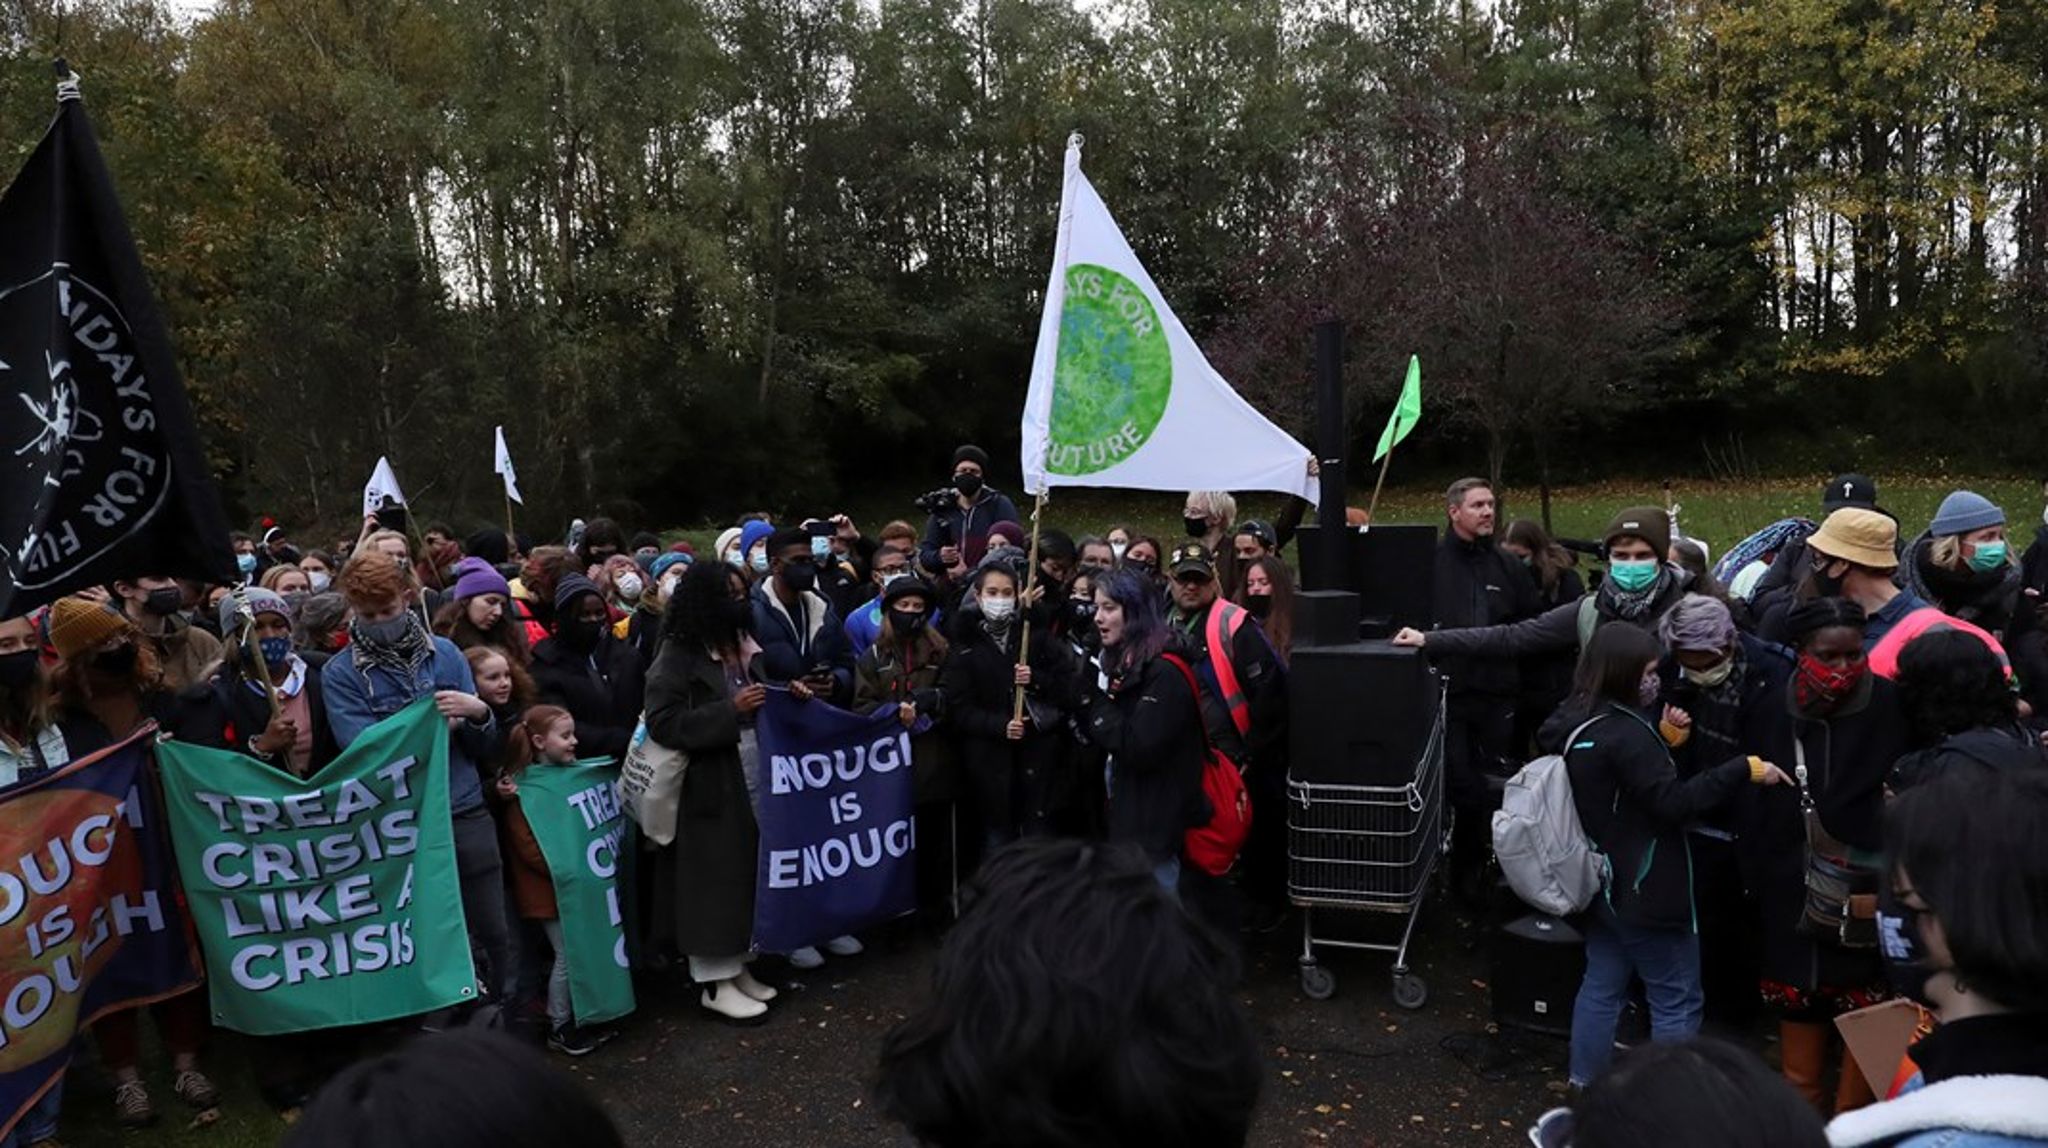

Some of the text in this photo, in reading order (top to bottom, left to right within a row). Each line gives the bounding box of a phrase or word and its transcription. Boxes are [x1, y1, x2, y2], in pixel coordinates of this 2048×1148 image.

[1107, 281, 1153, 338] FOR
[1045, 420, 1144, 467] UTURE
[81, 446, 156, 527] FOR
[195, 755, 418, 834] TREAT
[829, 791, 863, 825] IS
[202, 809, 418, 888] CRISIS
[26, 904, 76, 959] IS
[220, 874, 379, 938] LIKE
[231, 917, 415, 991] CRISIS
